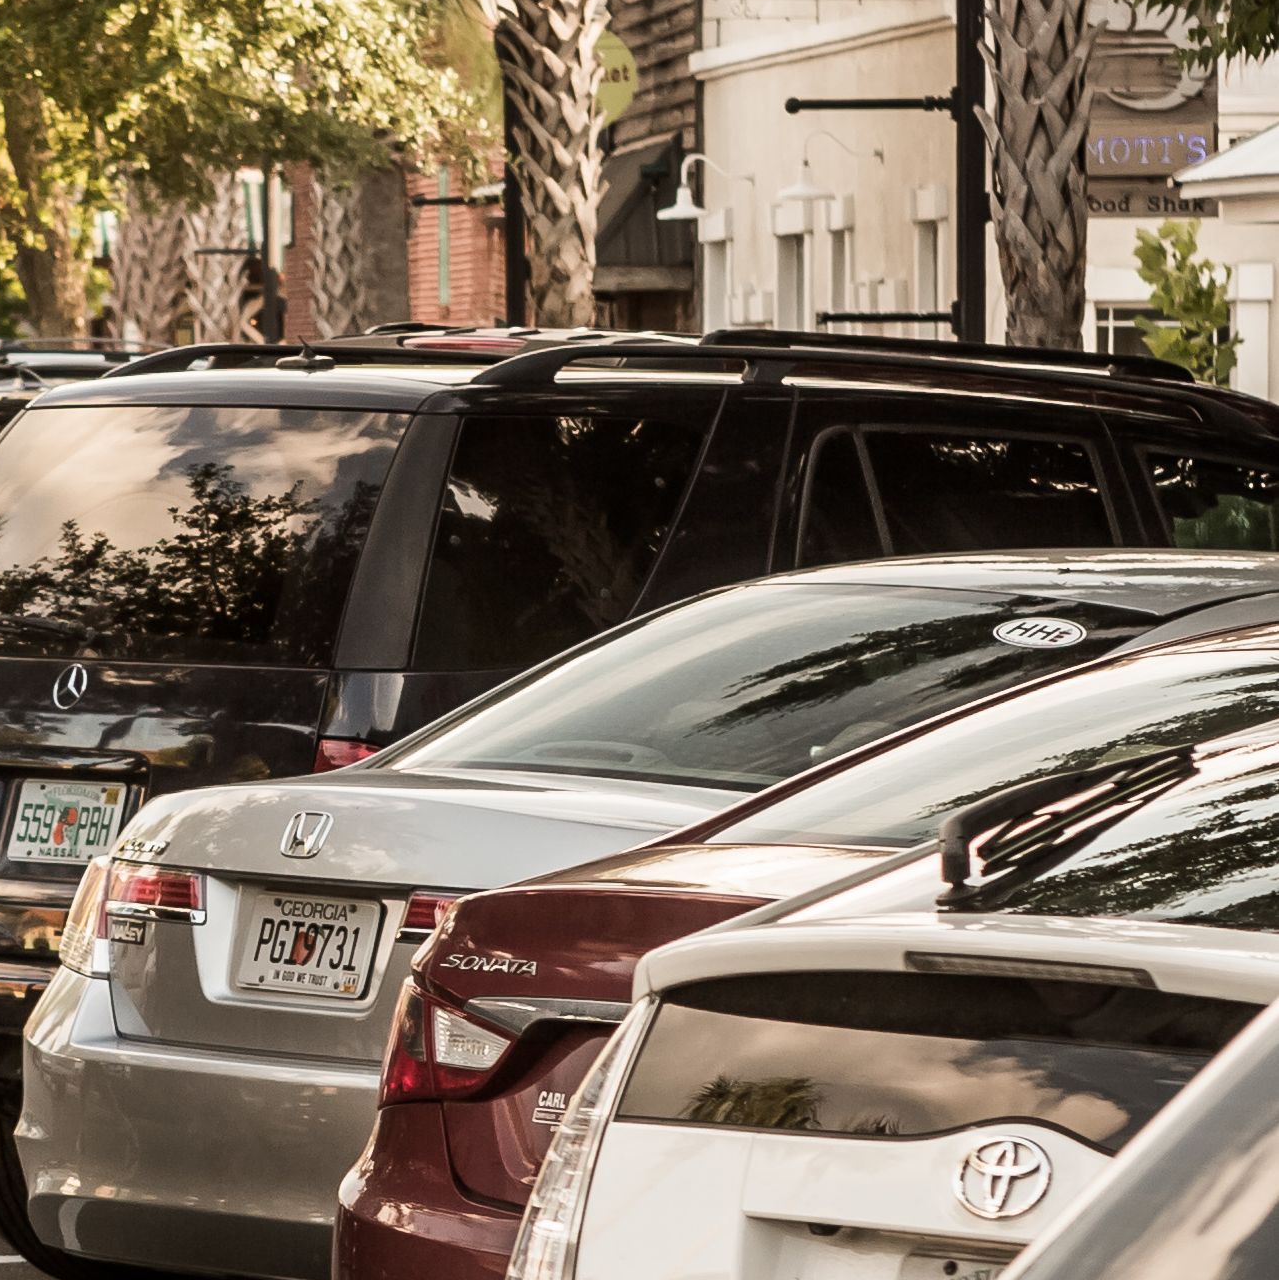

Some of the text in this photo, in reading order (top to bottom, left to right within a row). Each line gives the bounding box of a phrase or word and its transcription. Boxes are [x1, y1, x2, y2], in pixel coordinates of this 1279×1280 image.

[16, 803, 114, 846] 559 PBH
[38, 847, 82, 859] NASSAU
[280, 899, 349, 921] GEORGIA
[440, 954, 537, 976] SONATA
[538, 1090, 566, 1109] CARL
